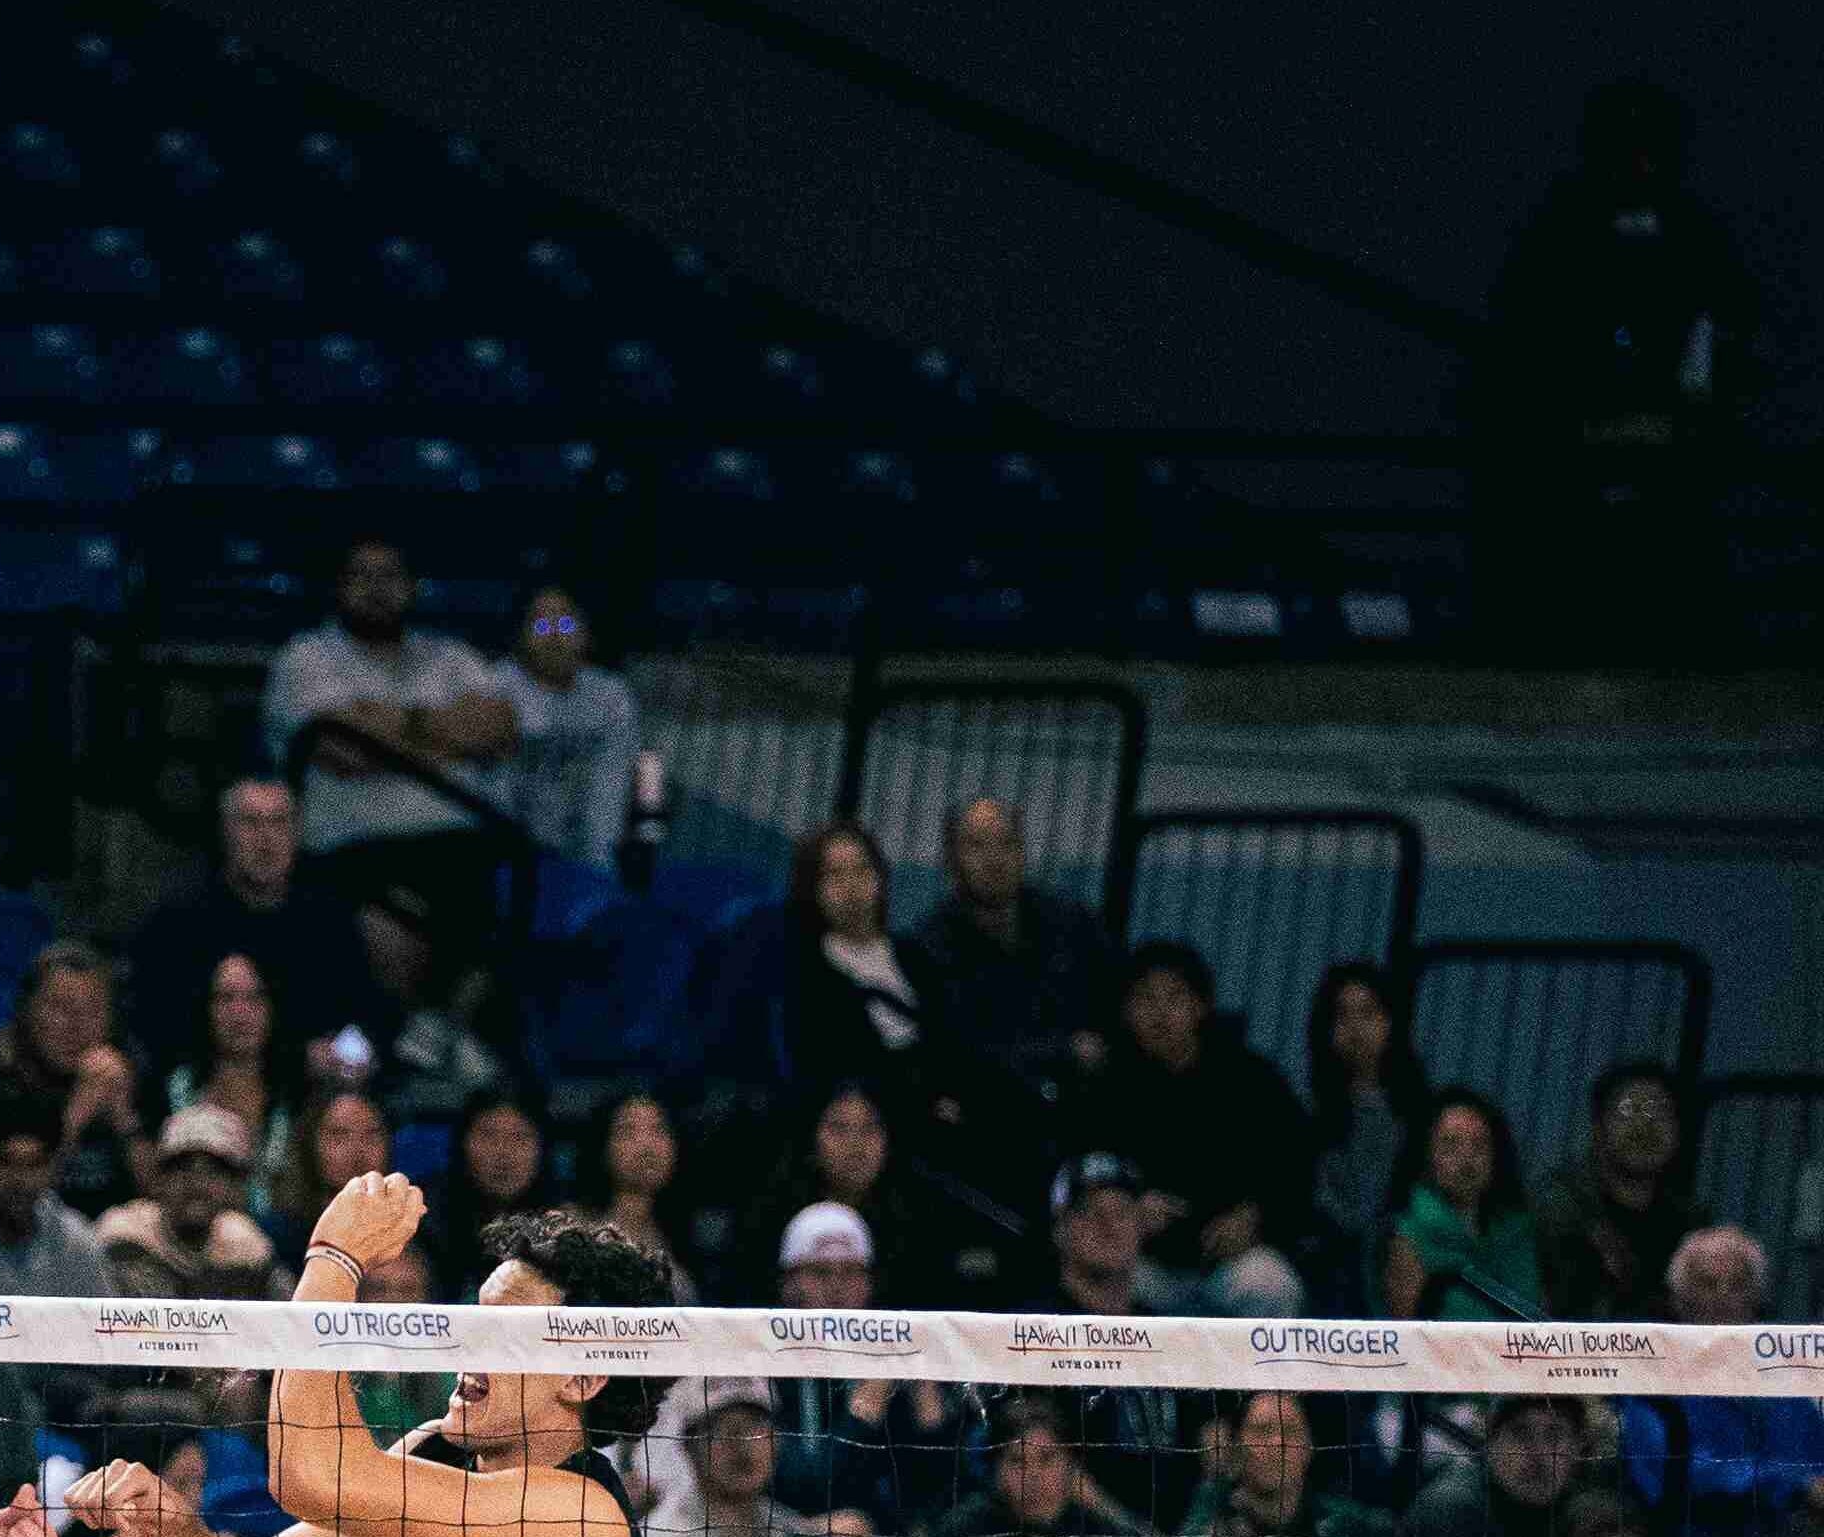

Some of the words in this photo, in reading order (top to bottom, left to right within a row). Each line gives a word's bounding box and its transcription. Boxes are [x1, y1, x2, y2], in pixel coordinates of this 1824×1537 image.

[314, 1312, 451, 1338] OUTRIGGER
[612, 1315, 682, 1339] TOURISM
[770, 1317, 914, 1343] OUTRIGGER
[1083, 1323, 1153, 1348] TOURISM
[1251, 1326, 1400, 1355] OUTRIGGER
[1580, 1330, 1656, 1356] TOURISM
[1050, 1359, 1123, 1370] AUTHORITY
[1546, 1368, 1620, 1379] AUTHORITY
